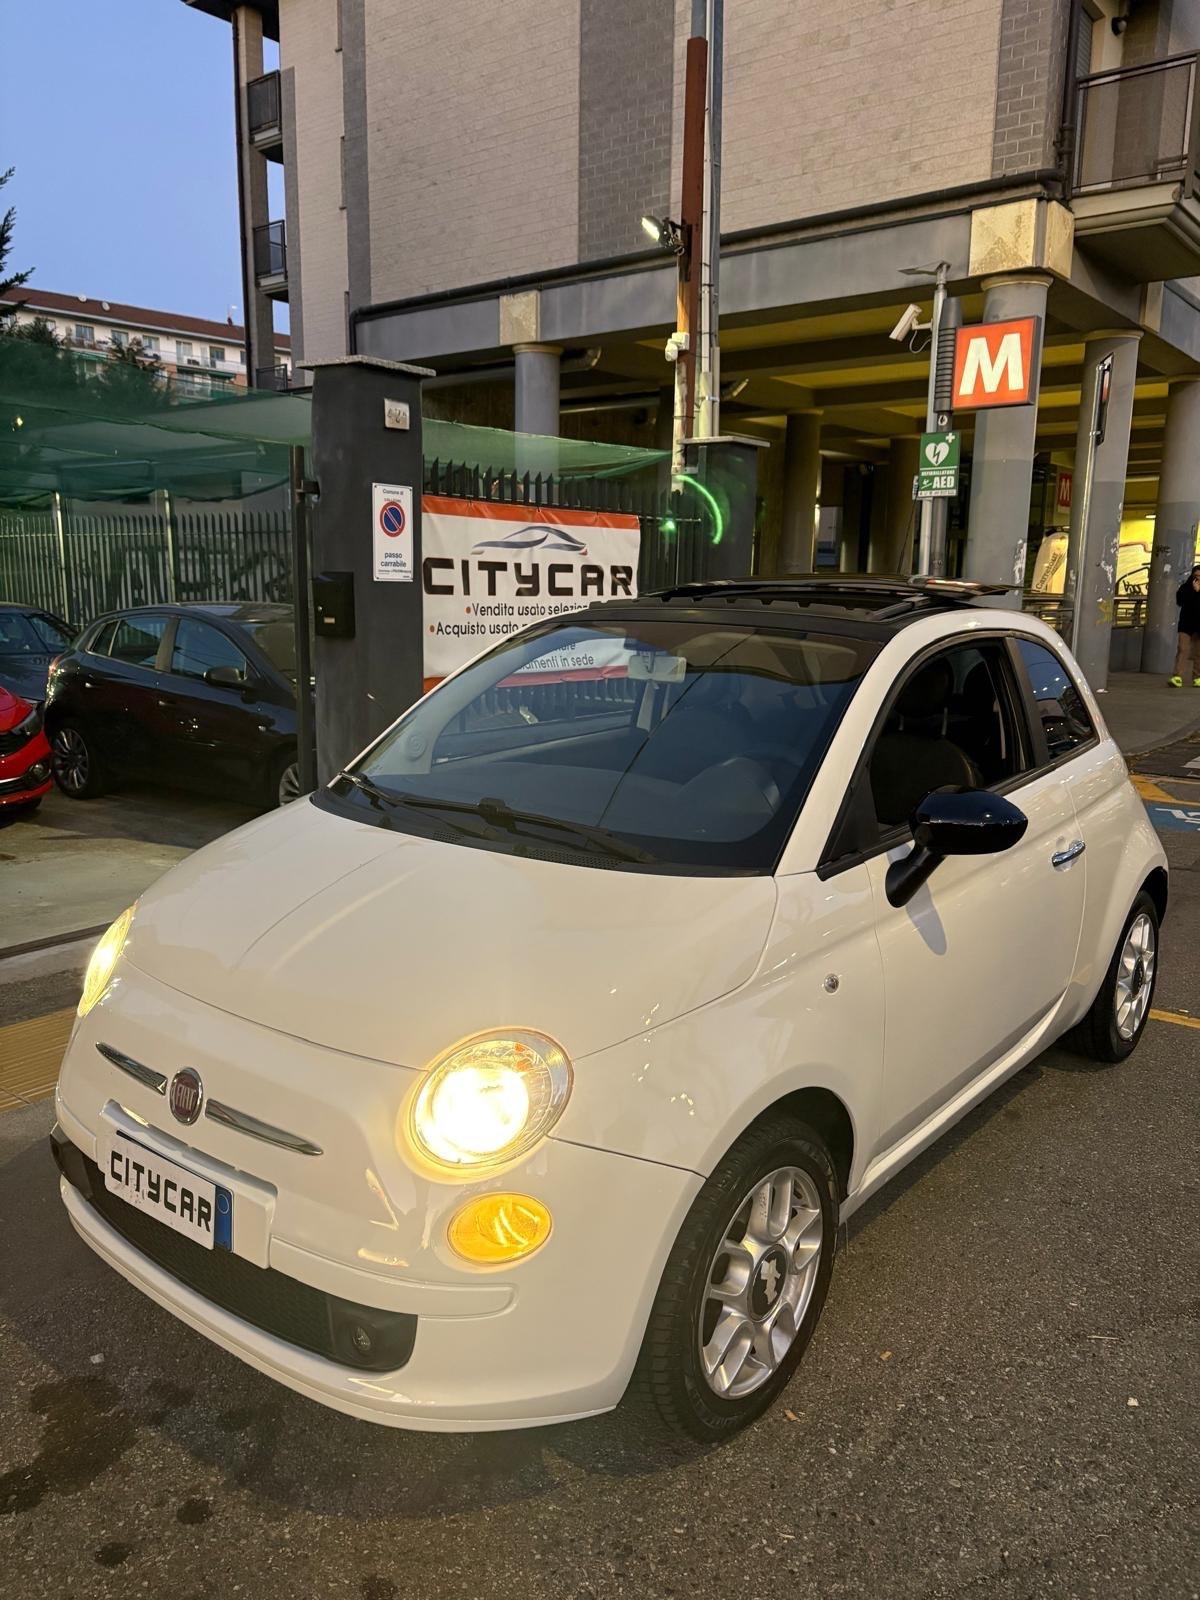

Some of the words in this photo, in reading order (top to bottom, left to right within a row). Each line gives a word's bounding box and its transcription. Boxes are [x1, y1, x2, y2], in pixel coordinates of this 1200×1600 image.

[959, 333, 1024, 395] M
[933, 476, 954, 488] AED
[1060, 478, 1070, 501] M
[380, 559, 407, 568] carrabile
[422, 557, 633, 597] CITYCAR
[472, 602, 514, 616] Vendita
[517, 603, 546, 616] usato
[436, 621, 487, 638] Acquisto
[560, 655, 570, 668] in
[570, 653, 594, 666] sede
[176, 1083, 197, 1110] FIAT
[110, 1150, 211, 1233] CITYCAR
